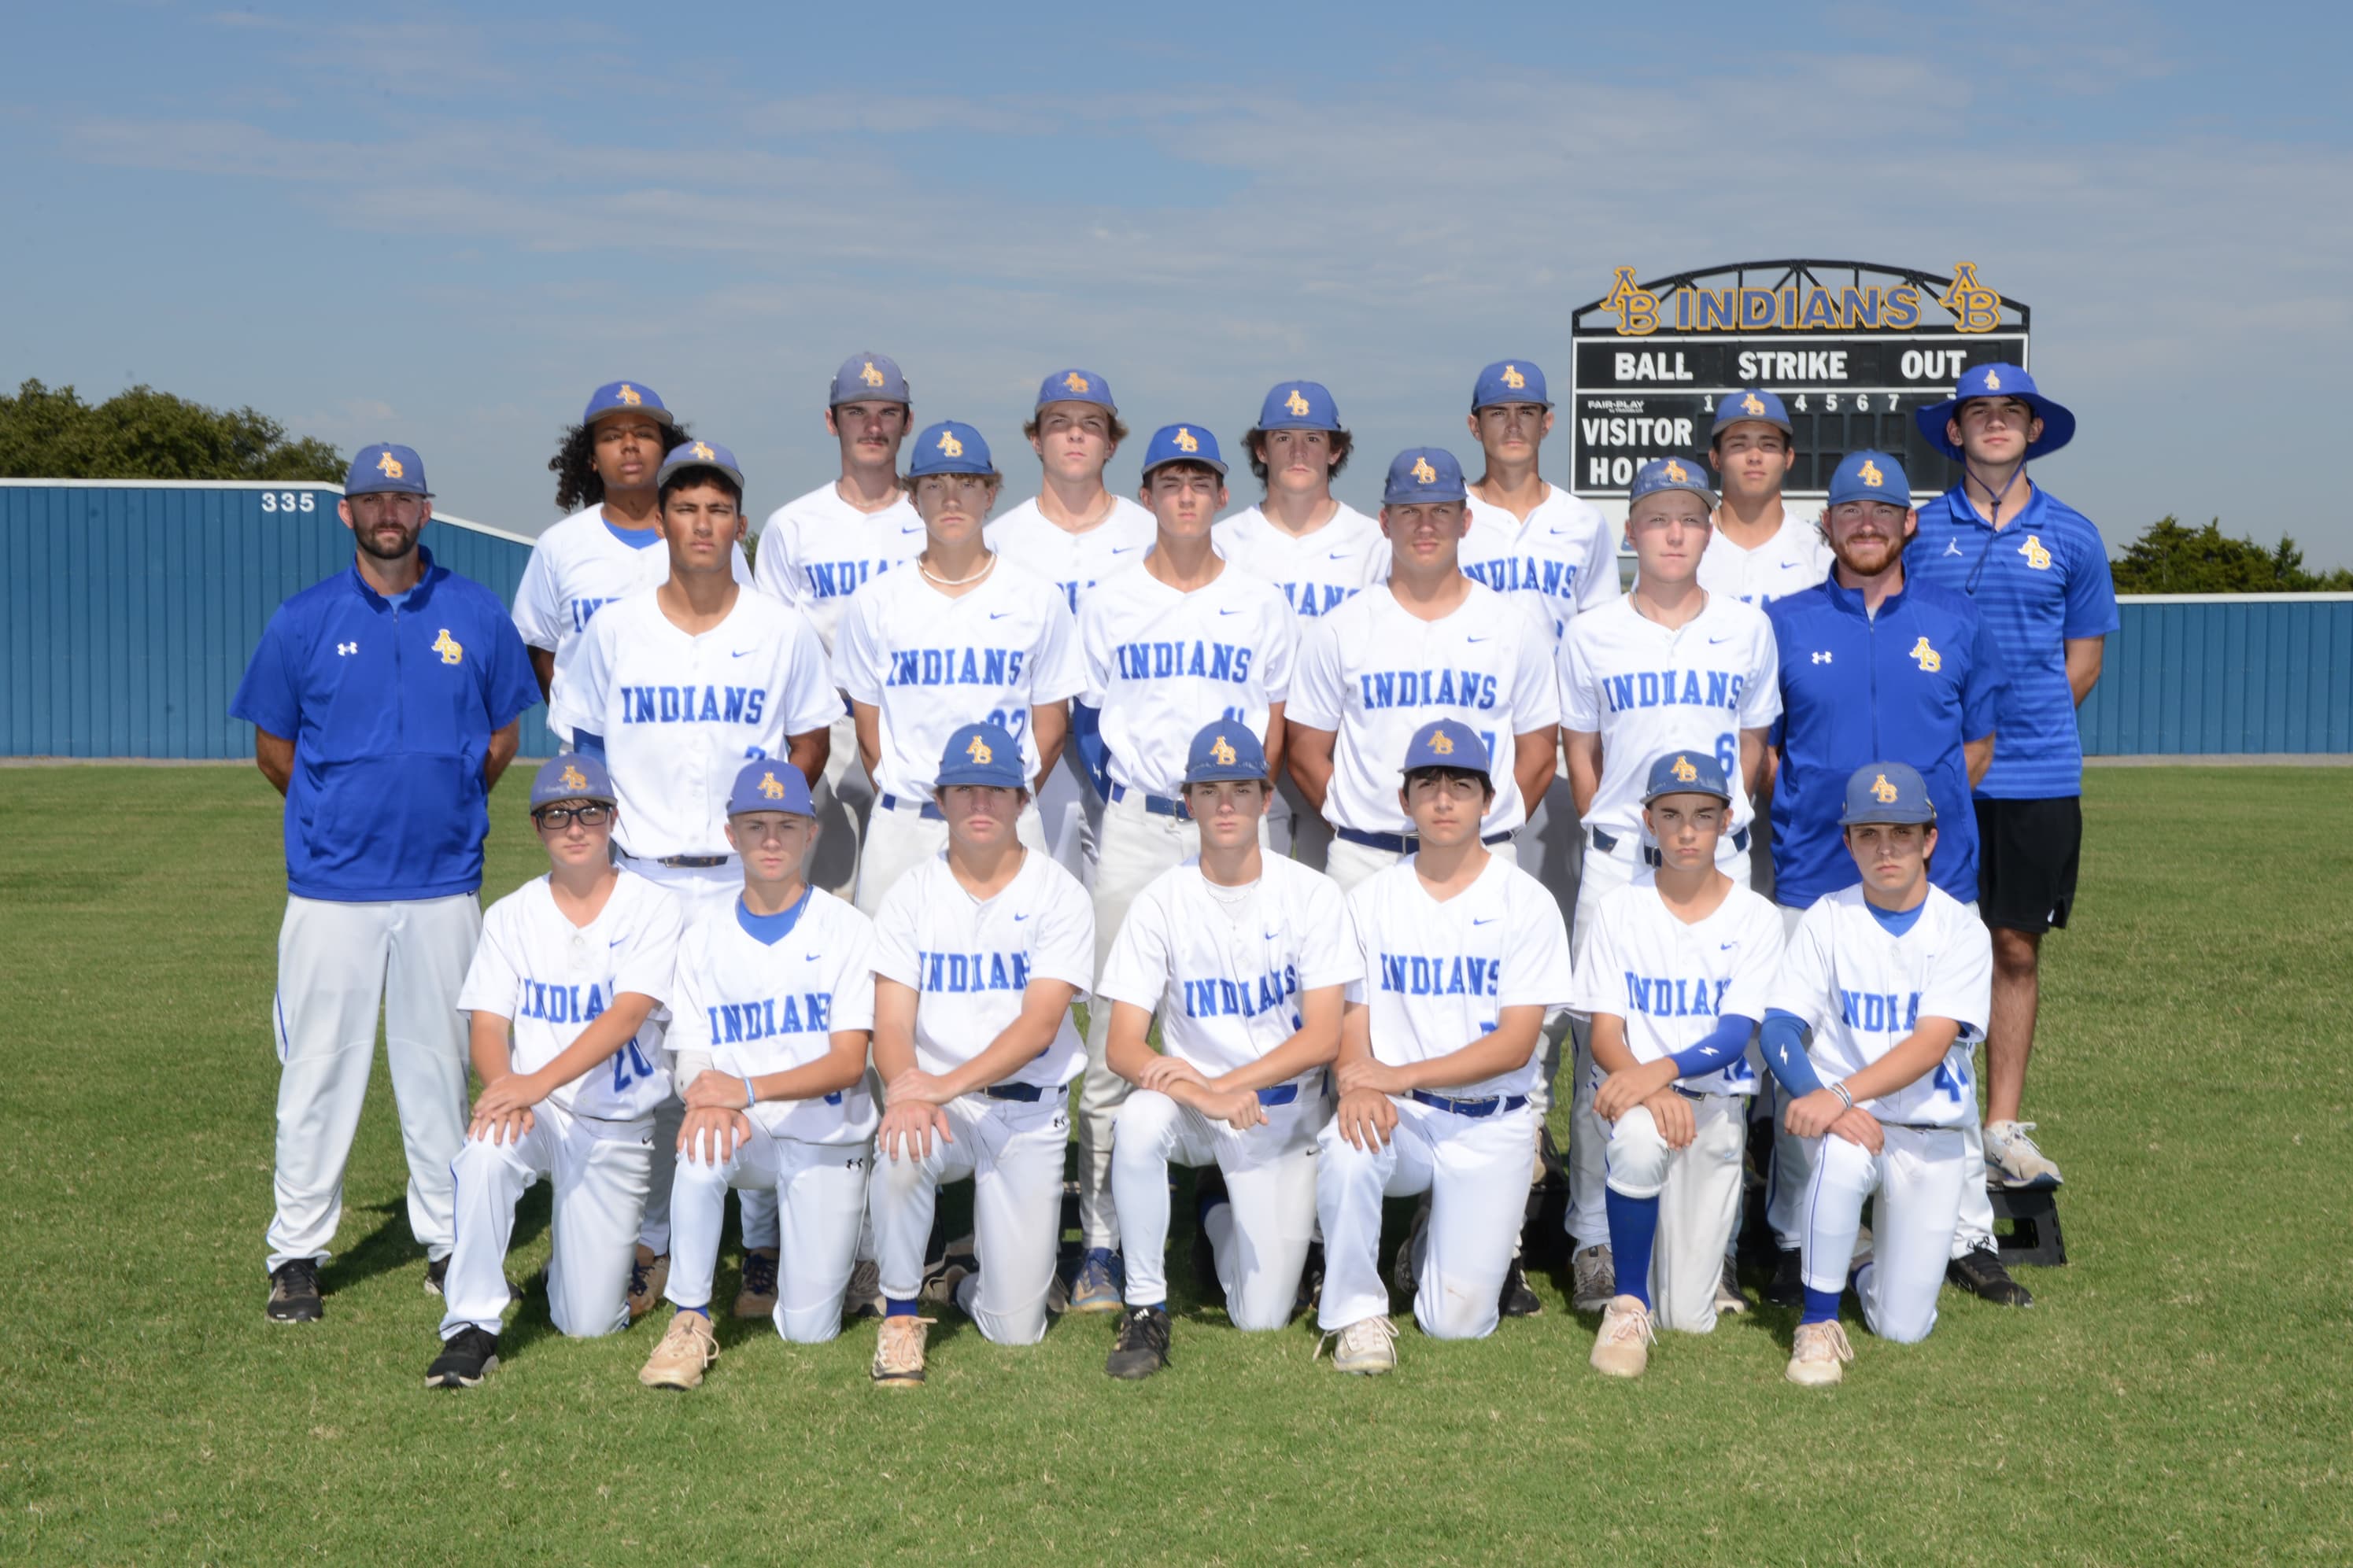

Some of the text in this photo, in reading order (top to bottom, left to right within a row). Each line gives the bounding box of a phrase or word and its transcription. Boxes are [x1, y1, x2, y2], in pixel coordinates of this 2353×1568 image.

[1600, 262, 2002, 335] AB INDIANS AB
[1614, 349, 1967, 381] BALL STRIKE OUT
[1704, 393, 1900, 412] 1 4 5 6 7
[1581, 417, 1693, 447] VISITOR
[261, 492, 315, 512] 335
[2016, 535, 2052, 570] AB
[1458, 556, 1577, 599] NDIANS
[430, 629, 463, 664] AB
[1117, 640, 1252, 684] INDIANS
[1908, 636, 1941, 672] AB
[886, 647, 1025, 687] INDIANS
[621, 685, 766, 725] INDIANS
[1361, 668, 1498, 710] INDIANS
[1602, 670, 1745, 713] INDIANS
[1716, 732, 1735, 780] 6
[1380, 951, 1501, 997] INDIANS
